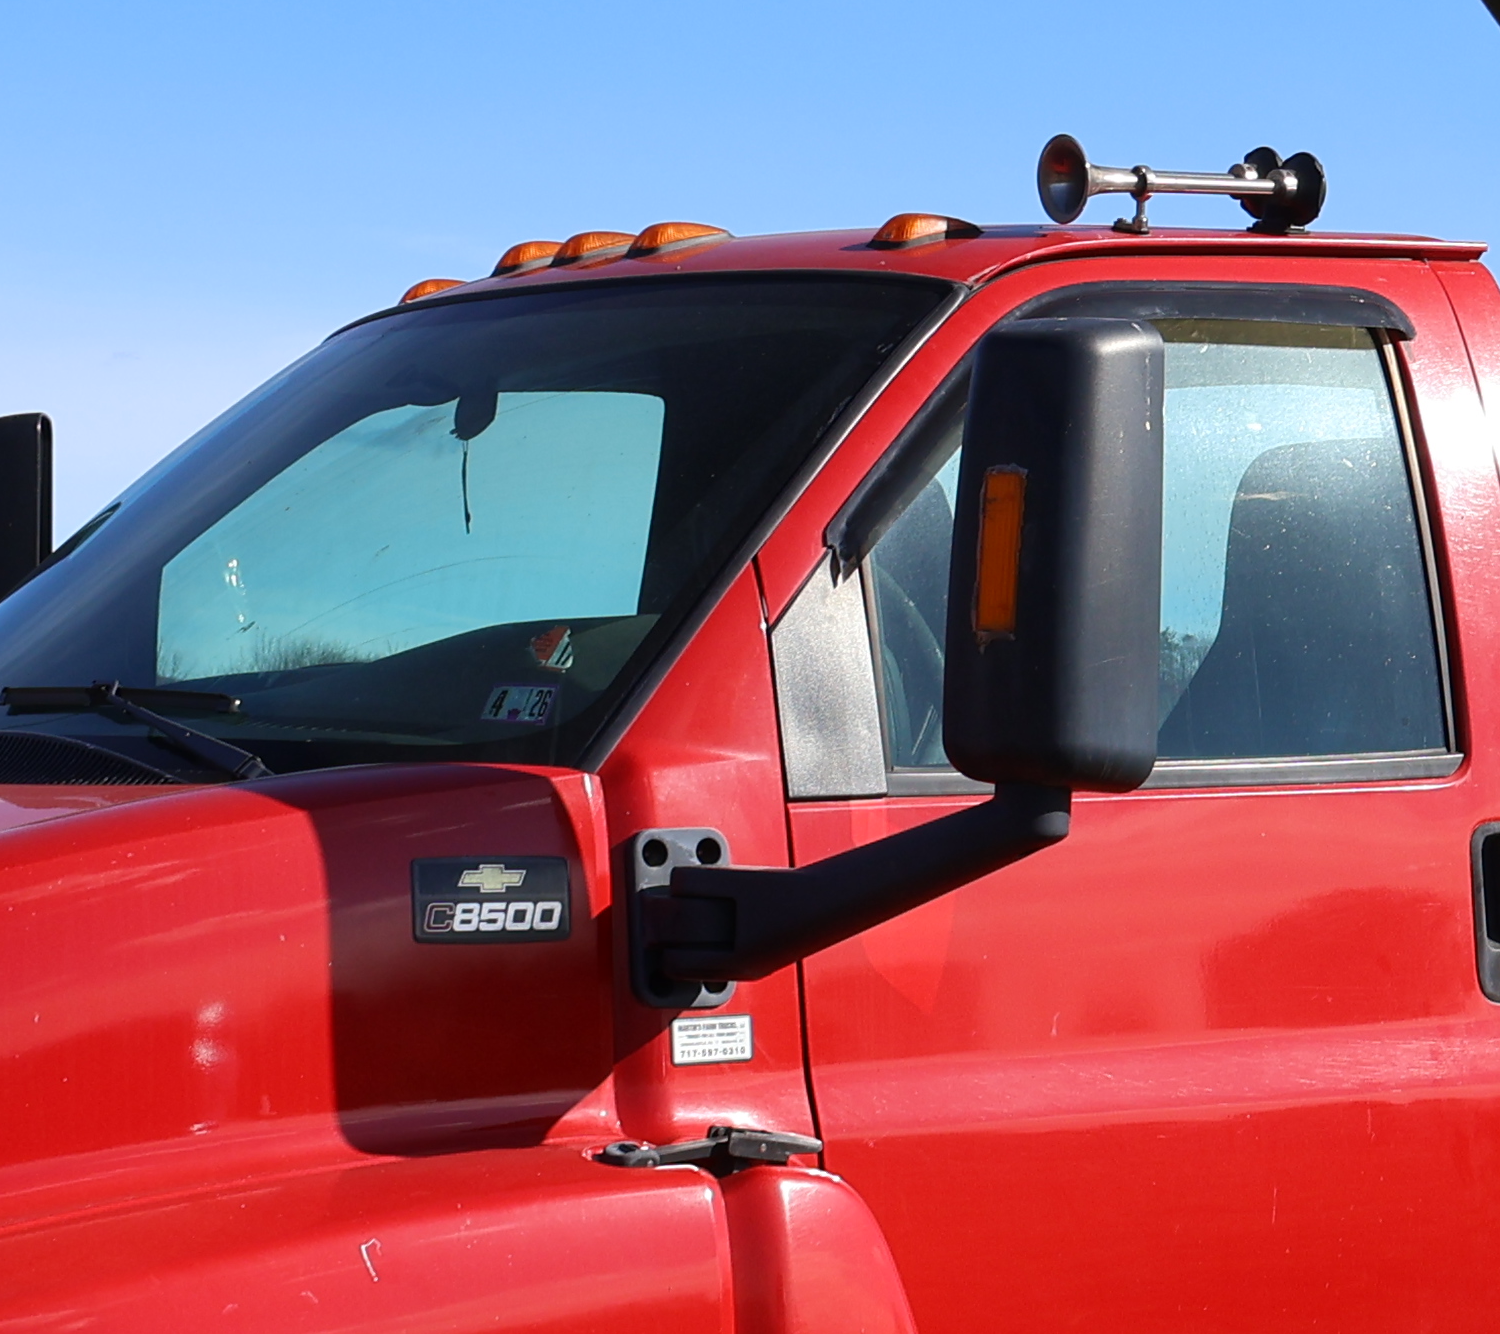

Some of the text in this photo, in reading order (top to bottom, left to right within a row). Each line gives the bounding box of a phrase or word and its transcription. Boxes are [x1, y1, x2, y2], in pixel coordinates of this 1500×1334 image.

[488, 689, 554, 718] 4 26
[424, 901, 562, 933] C8500
